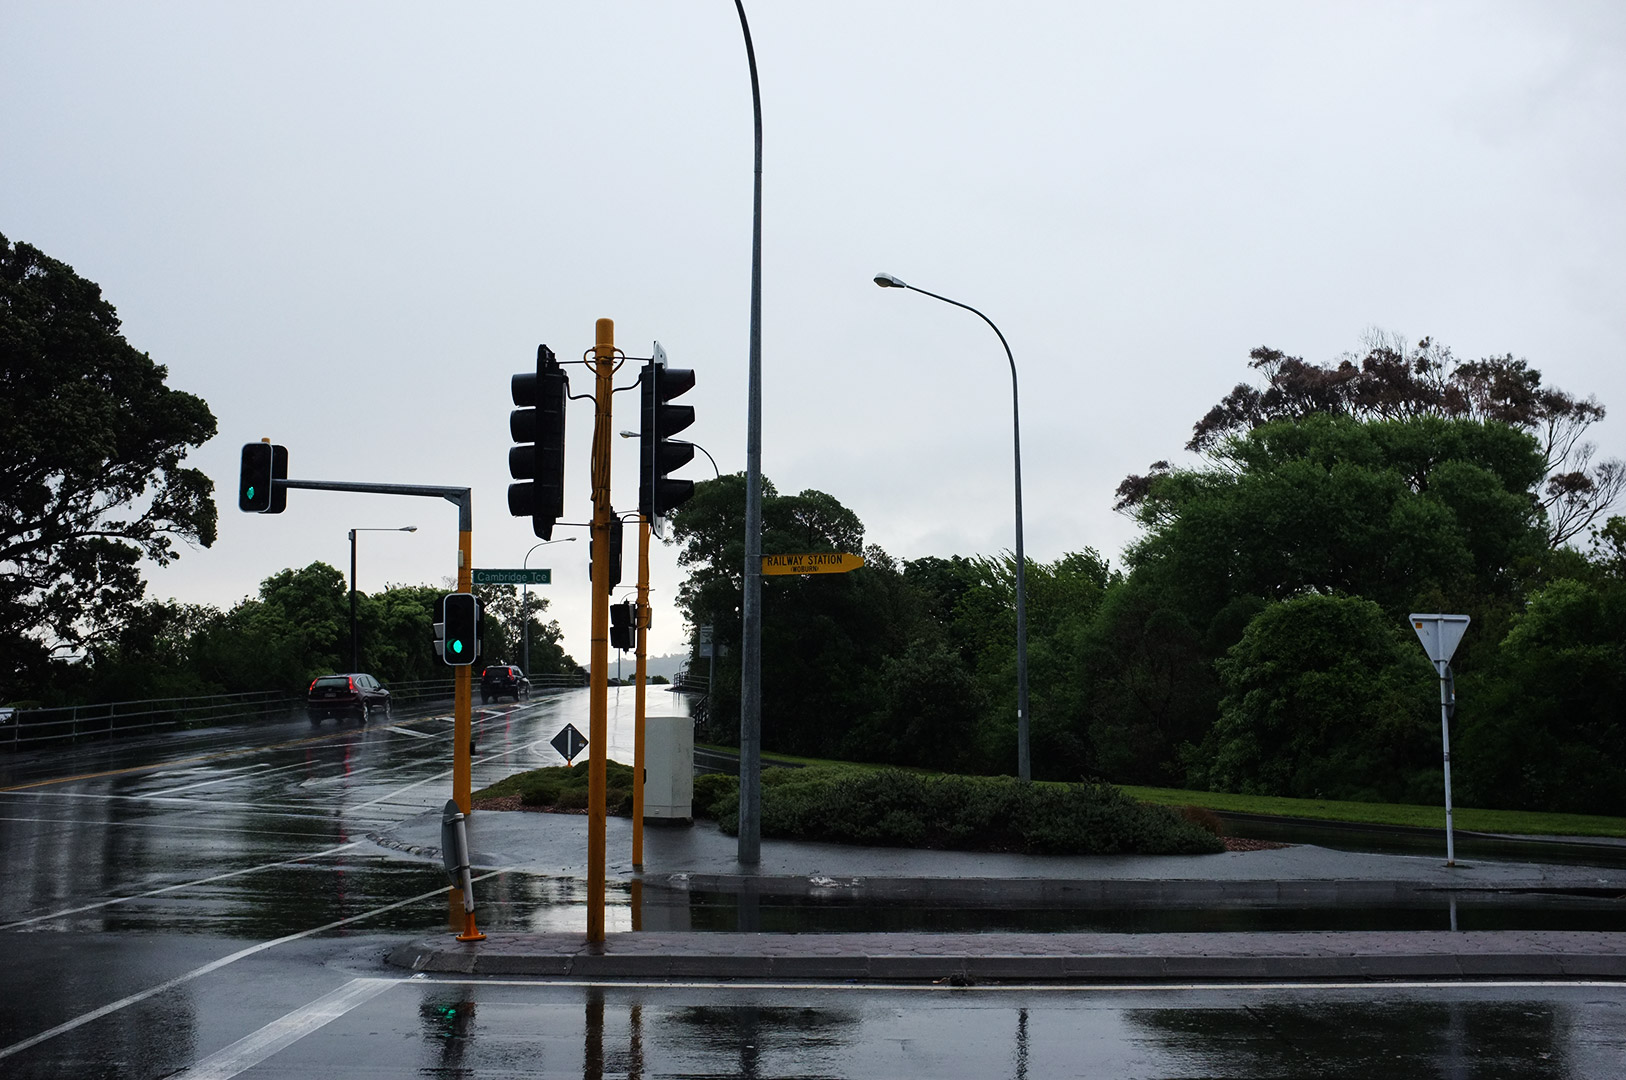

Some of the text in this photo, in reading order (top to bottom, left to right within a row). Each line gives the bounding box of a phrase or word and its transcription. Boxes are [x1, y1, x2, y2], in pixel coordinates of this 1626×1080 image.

[767, 555, 842, 566] RAILWAY STATION
[478, 572, 547, 583] Cambridge Tce
